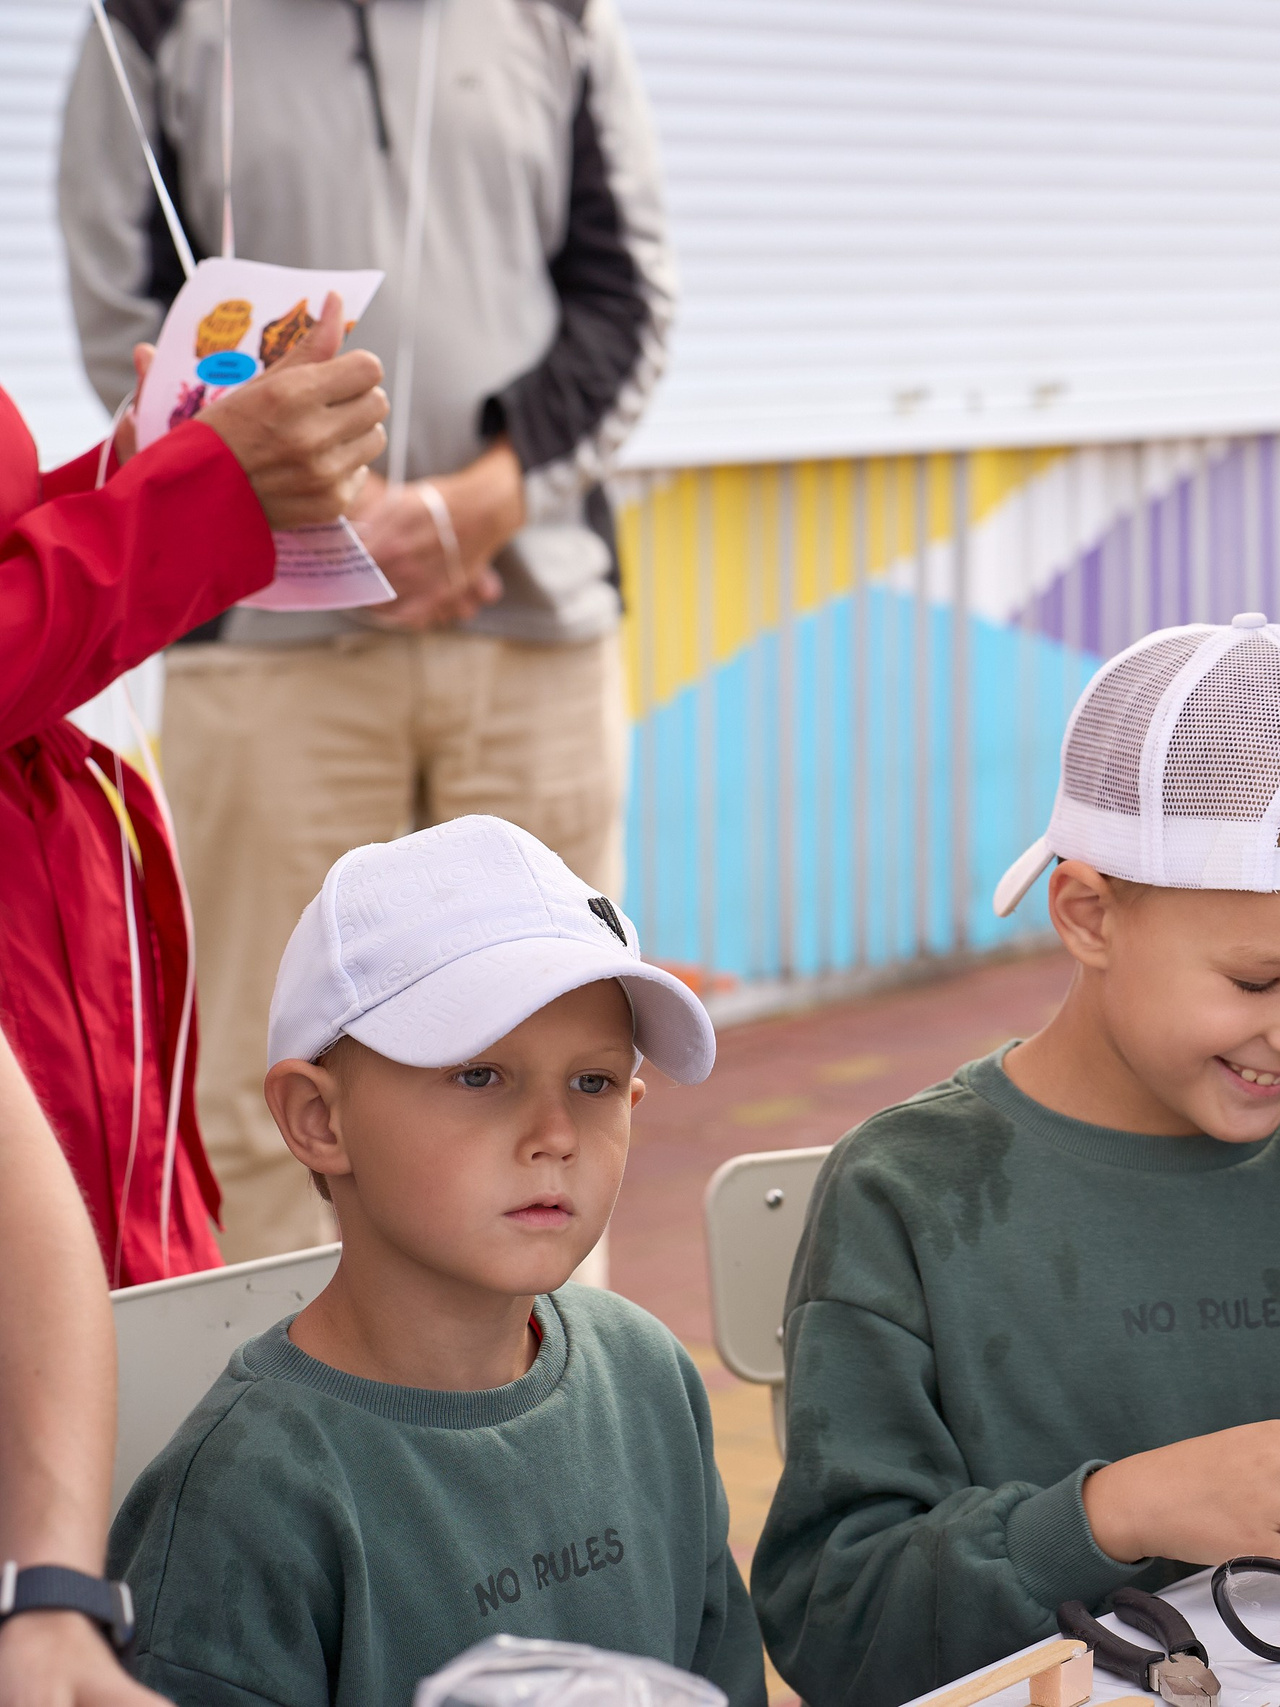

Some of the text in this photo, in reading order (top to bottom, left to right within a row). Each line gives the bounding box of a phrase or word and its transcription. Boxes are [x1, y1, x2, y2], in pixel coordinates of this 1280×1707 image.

[1122, 1300, 1176, 1338] NO
[474, 1528, 624, 1617] NO RULES
